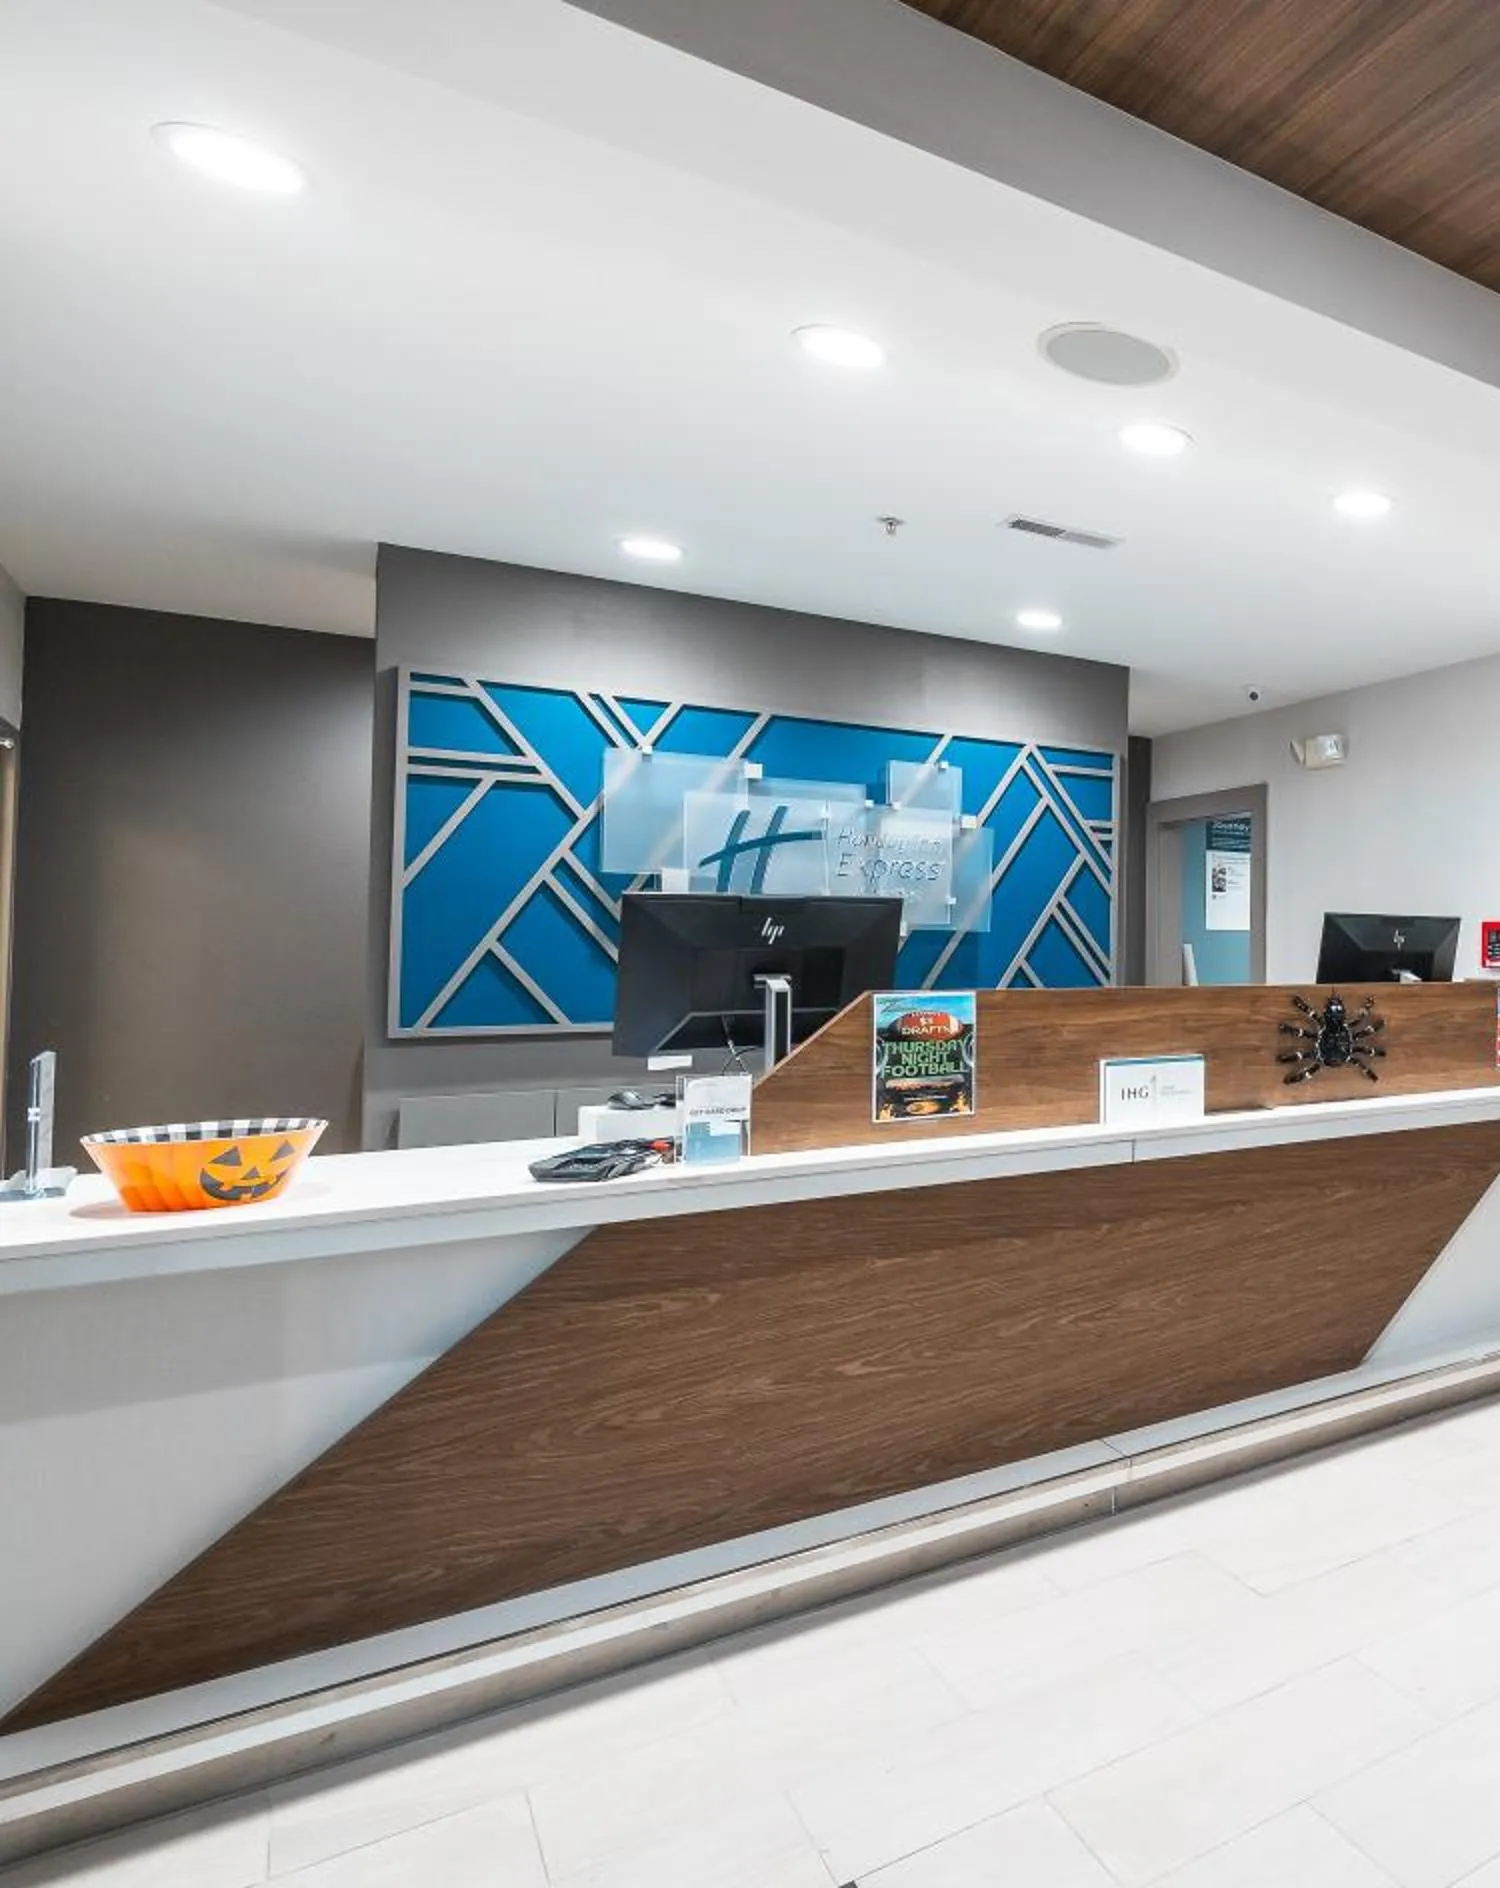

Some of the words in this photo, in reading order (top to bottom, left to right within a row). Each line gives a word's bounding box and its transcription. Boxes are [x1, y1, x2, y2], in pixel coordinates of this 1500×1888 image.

[836, 851, 943, 883] Express
[761, 916, 785, 945] hp
[884, 1040, 966, 1055] THURSDAY
[901, 1051, 950, 1066] NIGHT
[883, 1061, 967, 1077] FOOTBALL
[1121, 1087, 1149, 1101] IHG
